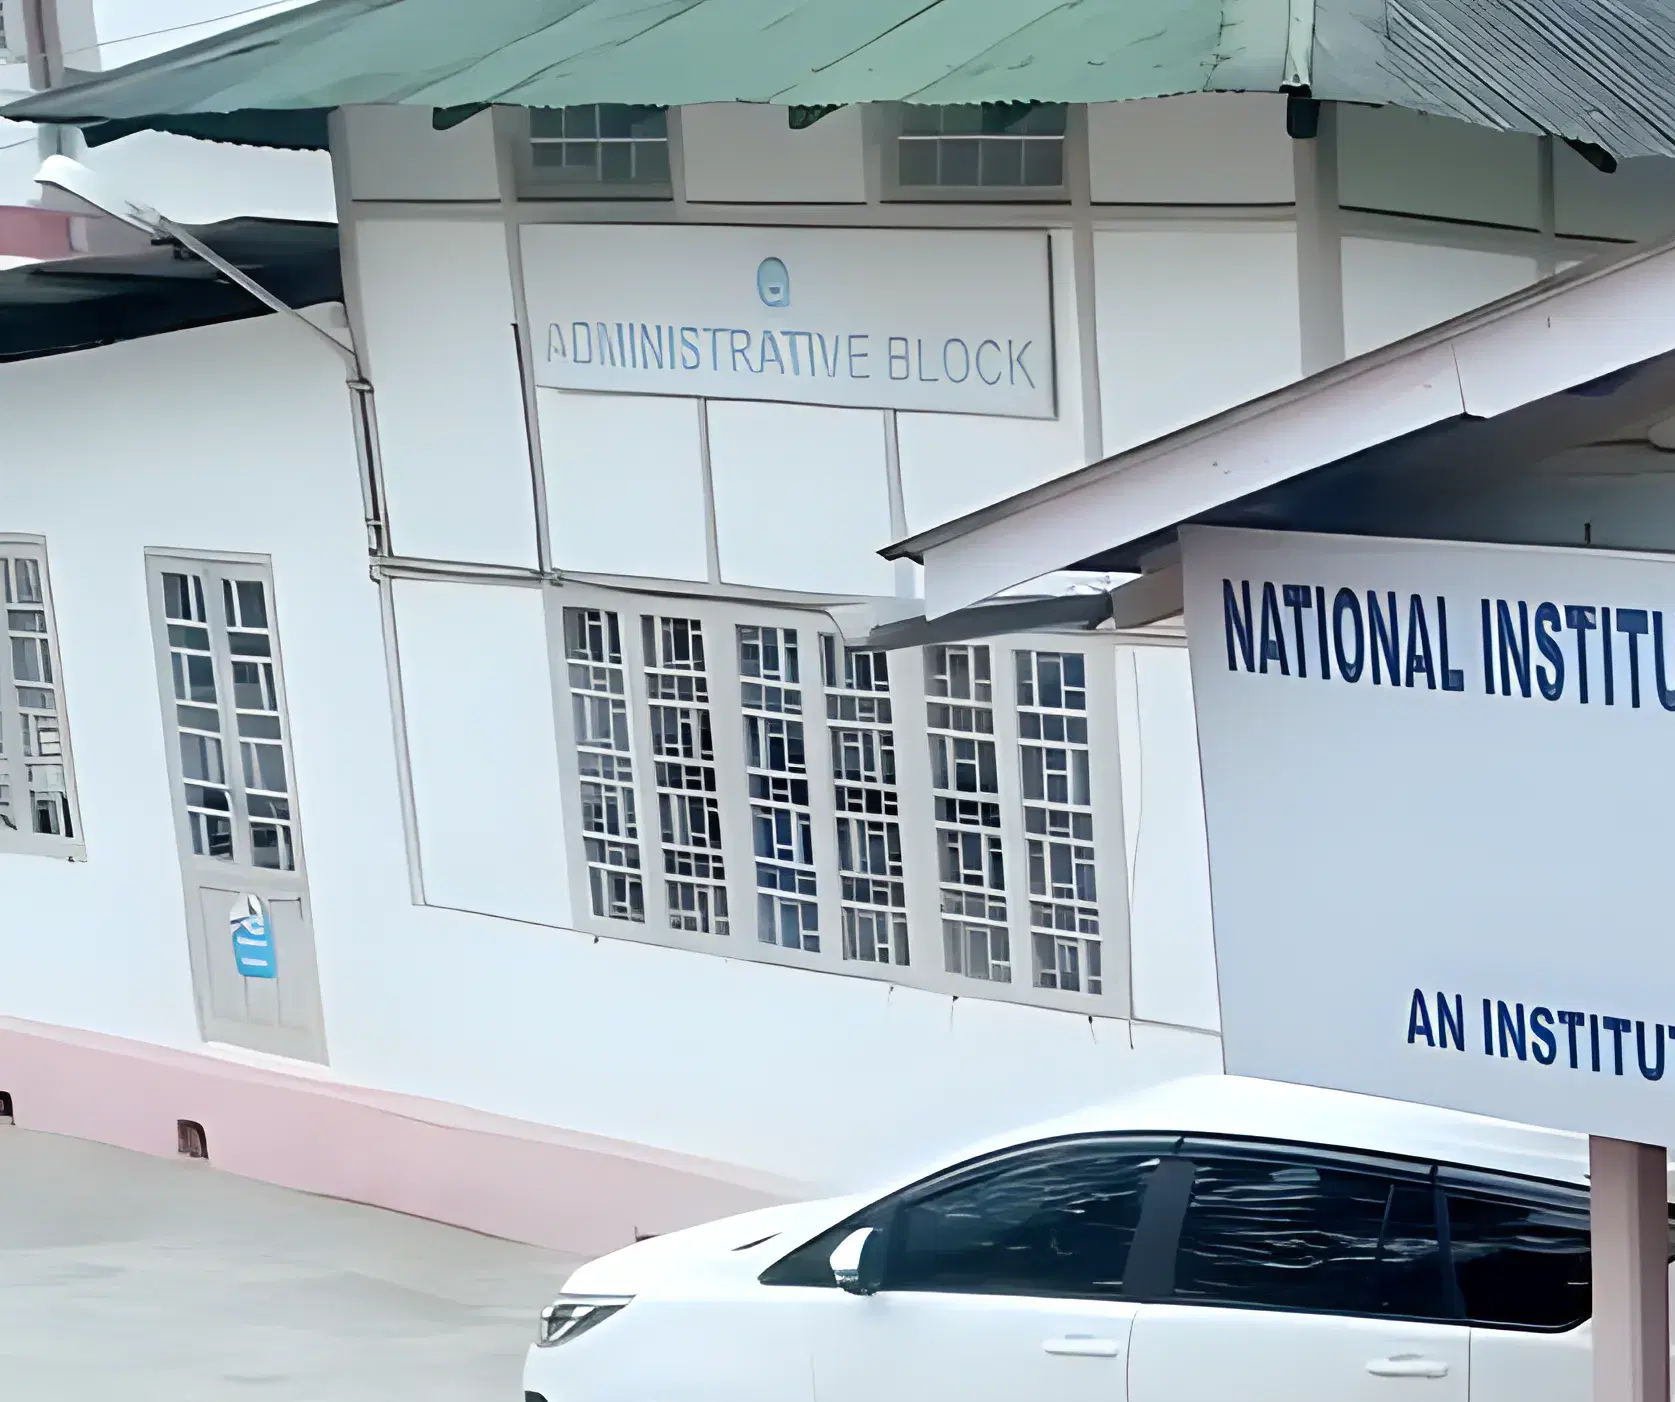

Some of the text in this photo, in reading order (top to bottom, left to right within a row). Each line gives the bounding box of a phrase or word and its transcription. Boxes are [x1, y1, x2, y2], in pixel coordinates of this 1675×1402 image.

[547, 321, 1035, 389] ADMINISTRATIVE BLOCK
[1222, 577, 1464, 692] NATIONAL
[1407, 988, 1466, 1052] AN
